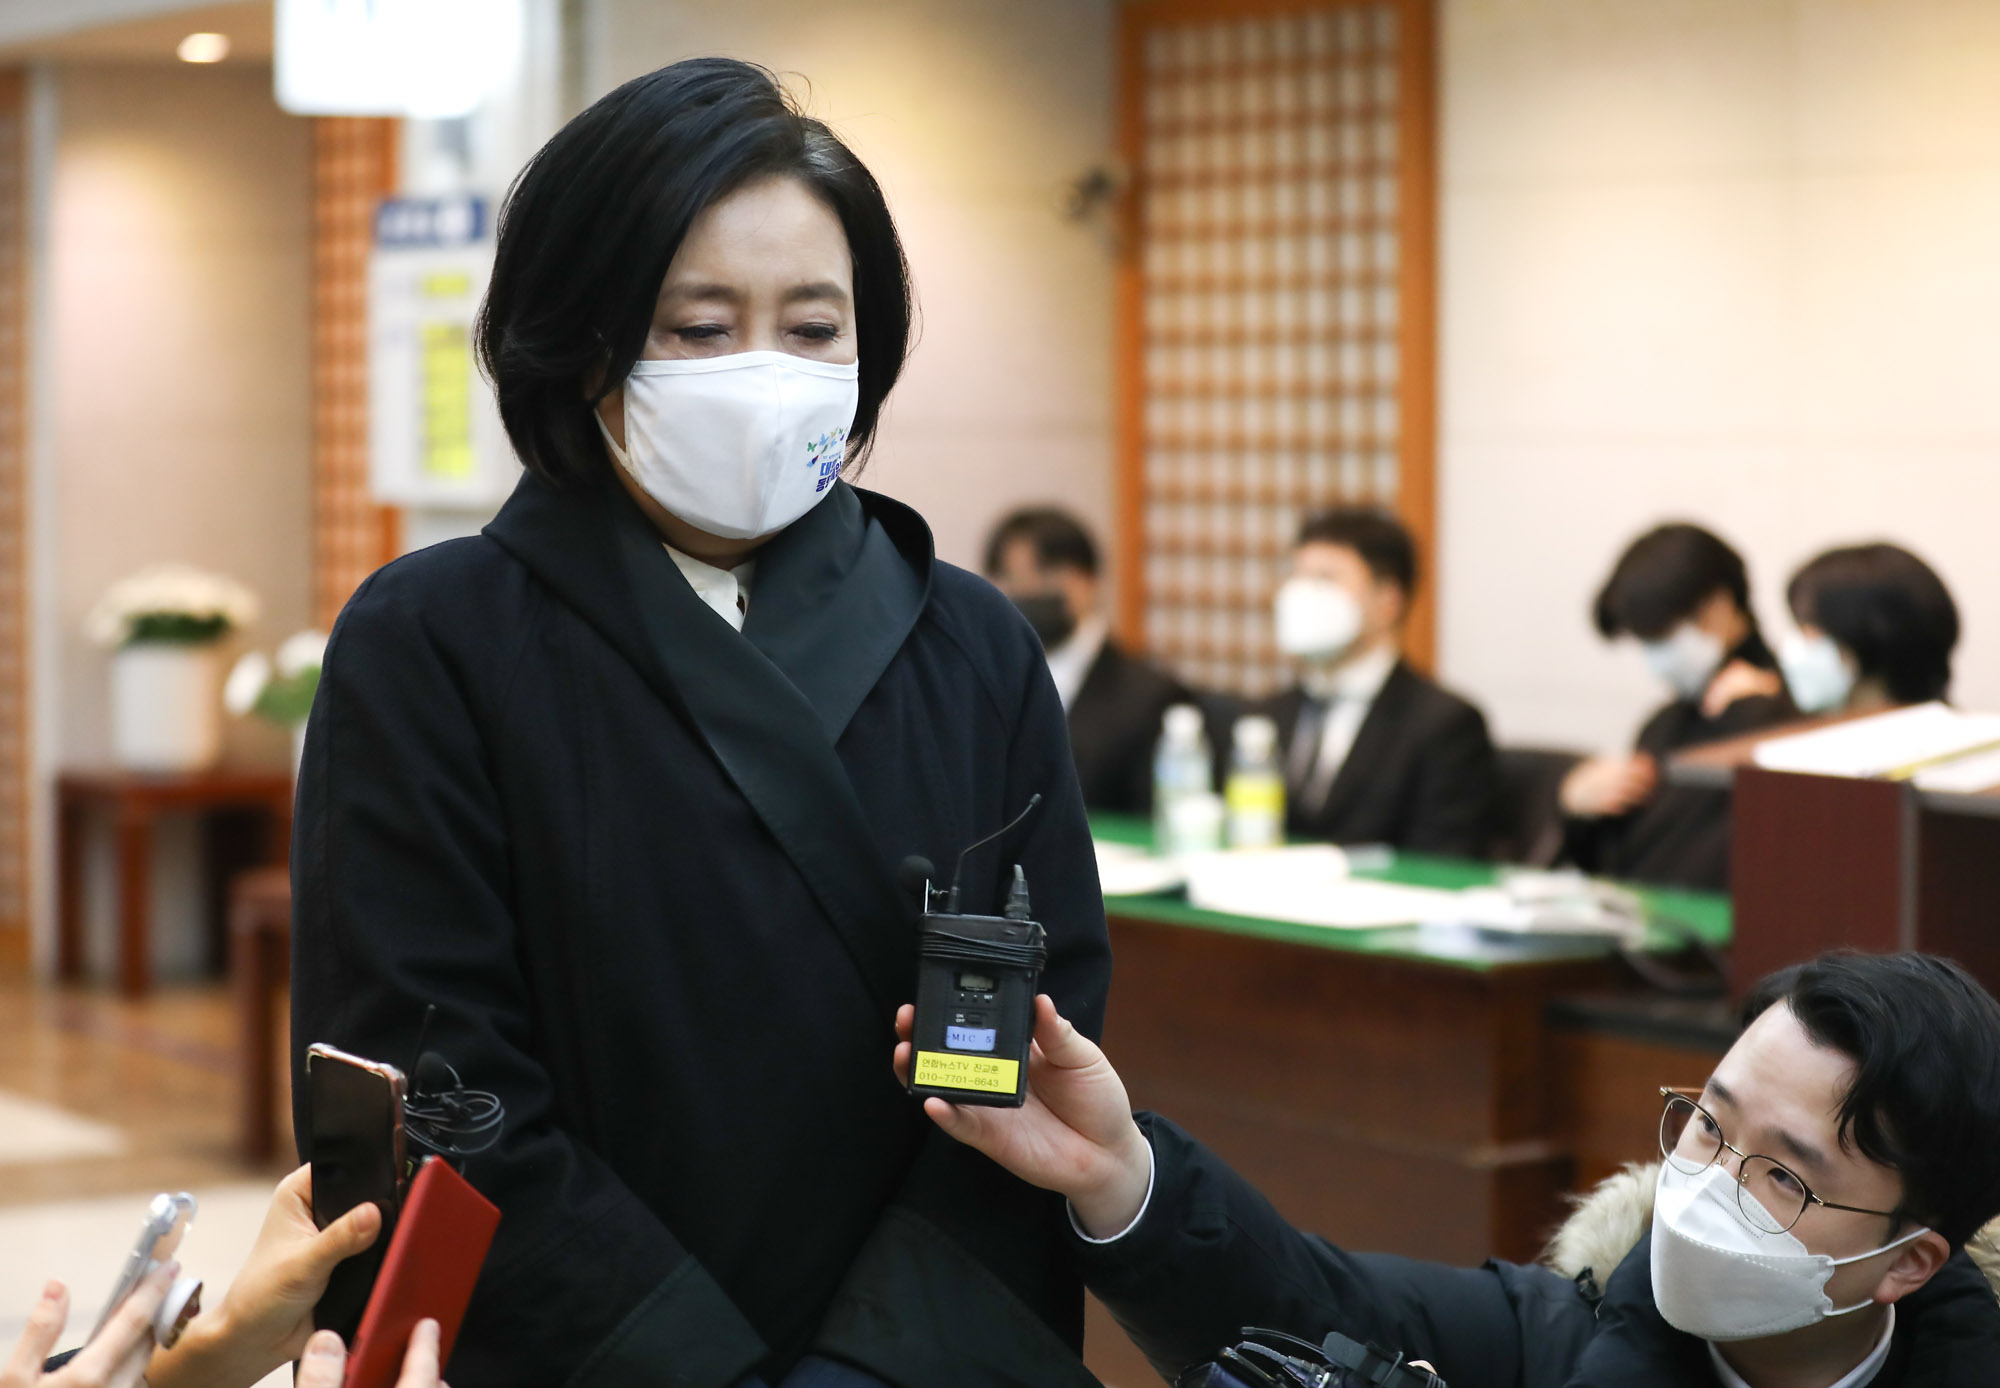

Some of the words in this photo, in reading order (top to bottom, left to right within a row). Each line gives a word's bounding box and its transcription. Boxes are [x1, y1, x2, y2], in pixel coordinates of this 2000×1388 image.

[986, 1035, 991, 1043] 5
[922, 1058, 969, 1070] 연합뉴스TV
[919, 1072, 999, 1087] 010-7701-8643
